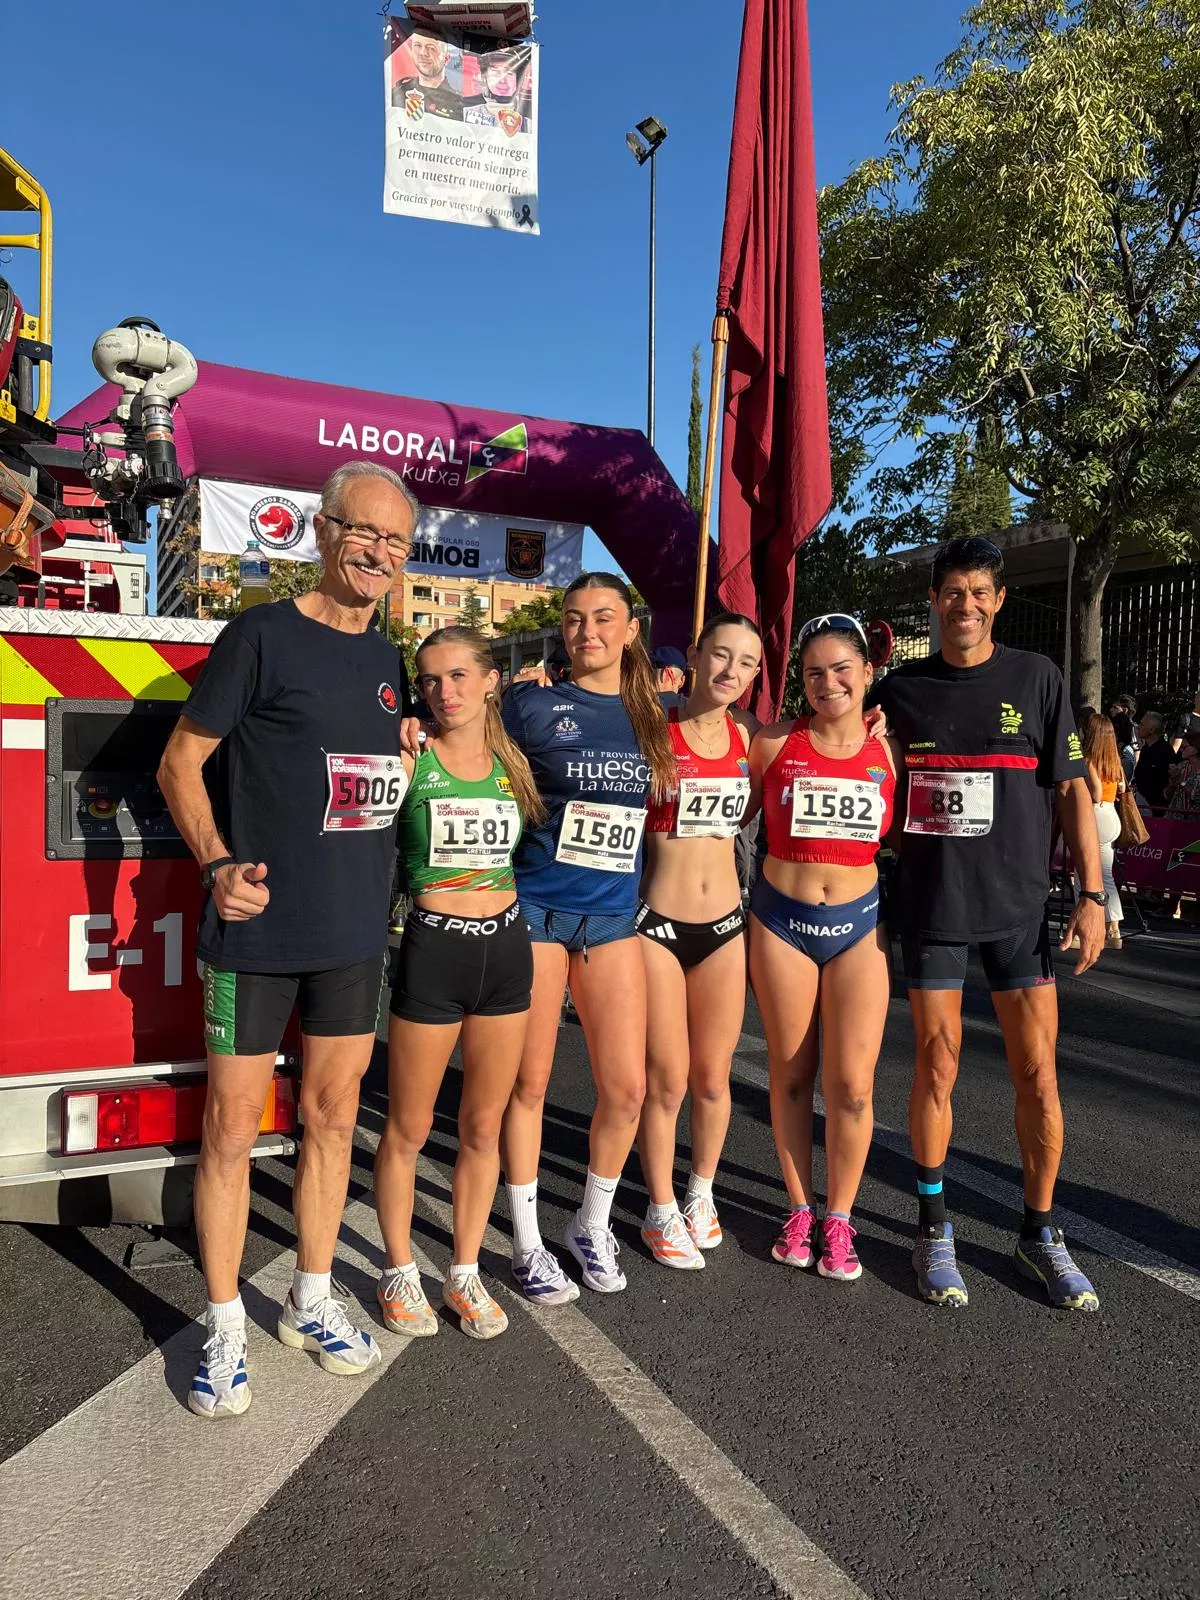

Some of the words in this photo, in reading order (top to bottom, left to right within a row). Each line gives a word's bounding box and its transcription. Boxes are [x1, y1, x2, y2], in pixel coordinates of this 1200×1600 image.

[397, 126, 442, 144] Vuestro
[446, 136, 475, 149] valor
[478, 142, 485, 154] y
[488, 145, 529, 161] entrega
[398, 148, 481, 170] permanecerán
[484, 161, 527, 178] siempre
[404, 168, 418, 179] en
[422, 171, 466, 186] nuestra
[469, 178, 521, 195] memoria.
[391, 190, 428, 205] Gracias
[430, 198, 447, 208] por
[449, 200, 483, 213] vuestro
[485, 205, 521, 219] ejemplo
[318, 418, 463, 465] LABORAL
[401, 462, 460, 487] kutxa
[250, 497, 277, 520] BOMBEROS
[279, 497, 304, 525] ZARAGOZA
[427, 535, 463, 546] POPULAR
[552, 704, 575, 712] 42K
[1001, 726, 1019, 734] CPEI
[581, 750, 595, 758] TU
[337, 776, 400, 806] 5006
[417, 780, 450, 790] VIATOR
[686, 795, 745, 818] 4760
[803, 793, 873, 821] 1582
[931, 790, 964, 815] 88
[443, 819, 510, 845] 1581
[570, 818, 636, 850] 1580
[1126, 845, 1163, 860] kutxa
[615, 862, 632, 870] 42K
[443, 918, 498, 936] PRO
[789, 918, 854, 937] HINACO
[68, 912, 183, 992] E-1
